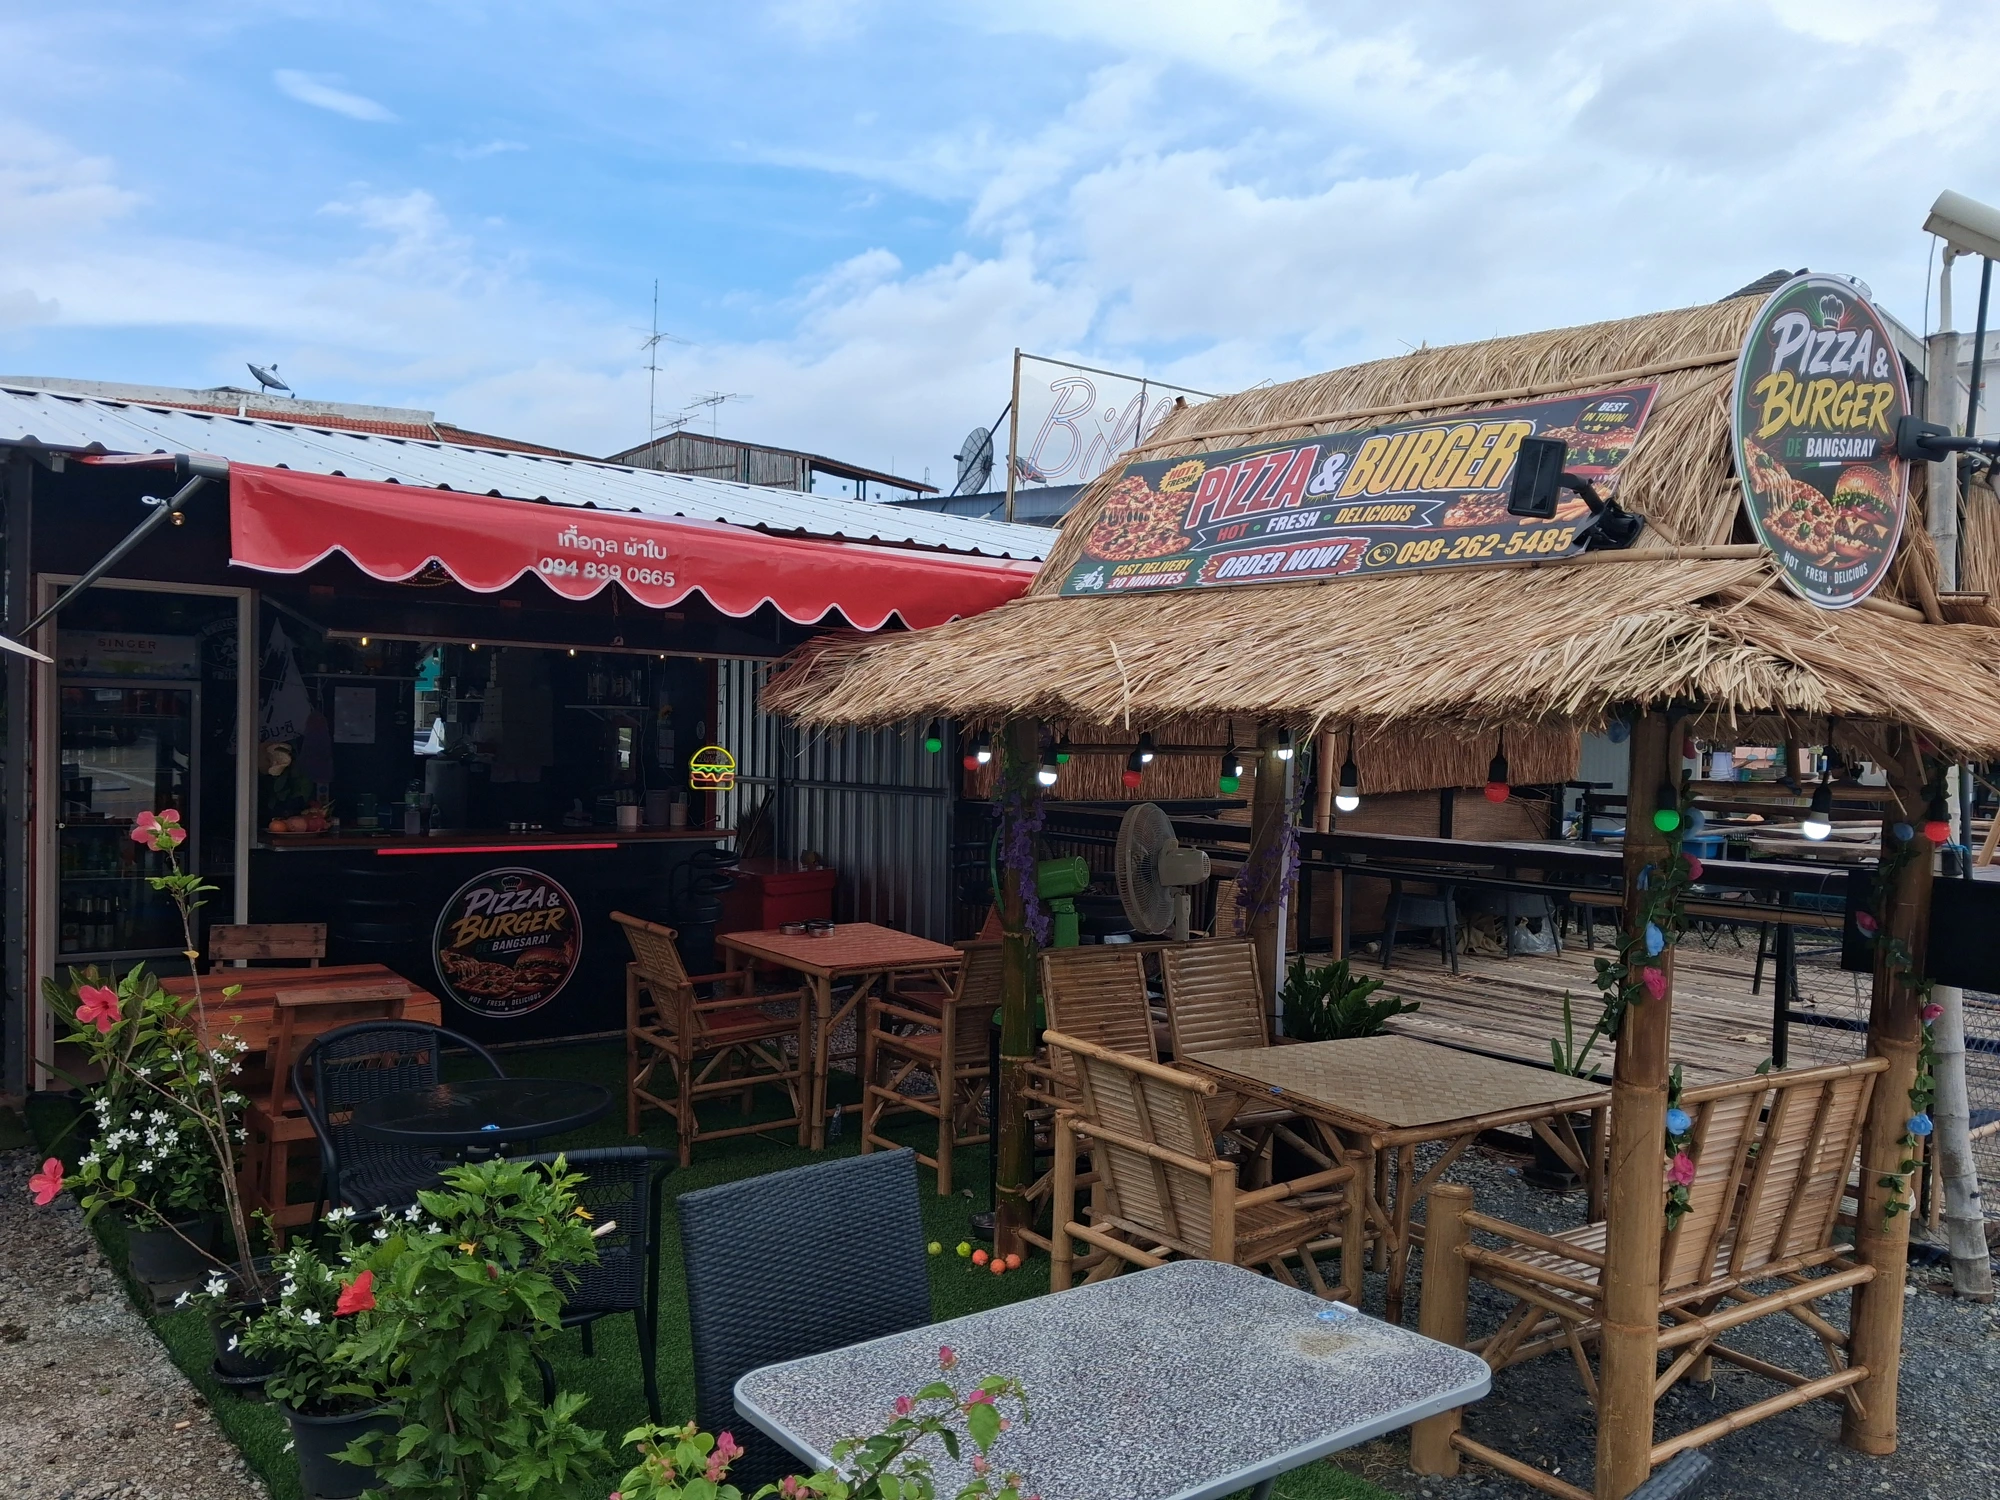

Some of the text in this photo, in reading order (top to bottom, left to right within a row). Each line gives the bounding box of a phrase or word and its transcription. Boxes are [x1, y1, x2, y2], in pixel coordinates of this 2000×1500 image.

[1771, 312, 1889, 379] PIZZA &
[1582, 412, 1629, 423] IN TOWN!
[1598, 402, 1630, 412] BEST
[1753, 370, 1894, 440] BURGER
[1785, 437, 1876, 458] DE BANGSARAY
[1166, 474, 1196, 488] FRESH!
[1168, 466, 1193, 480] HOT
[1185, 420, 1536, 529] PIZZA & BURGER
[1216, 504, 1416, 542] HOT FRESH DELICIOUS
[558, 524, 667, 560] เกื้อกูล ผ้าใบ
[1396, 526, 1577, 564] 098-262-5485
[538, 557, 675, 587] 094 839 0665
[1112, 558, 1194, 576] FAST DELIVERY
[1215, 543, 1351, 580] ORDER NOW!
[1783, 550, 1869, 584] HOT FRESH DELICIOUS
[1108, 572, 1186, 589] 30 MINUTES
[97, 638, 157, 650] SINGER
[463, 885, 560, 917] PIZZA &
[449, 907, 566, 948] BURGER
[491, 934, 552, 951] BANGSARAY
[468, 991, 542, 1006] HOT FRESH DELICIOUS
